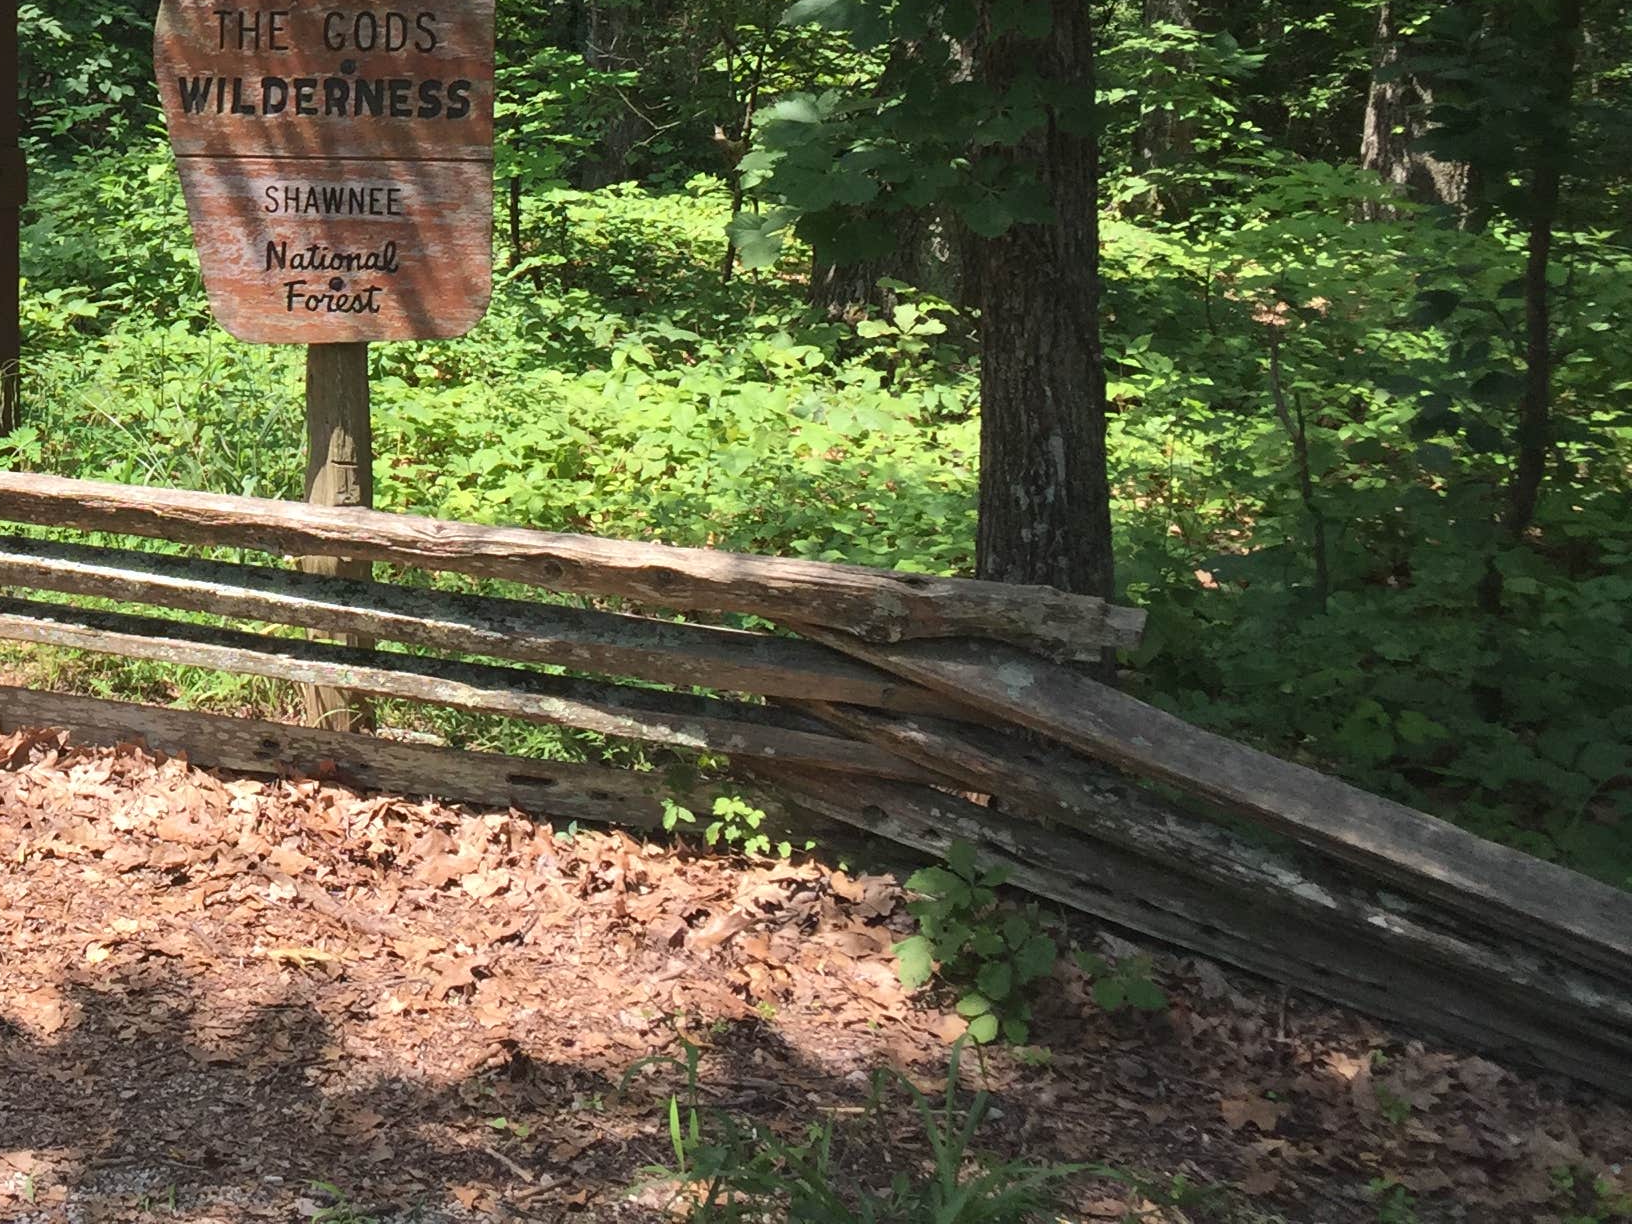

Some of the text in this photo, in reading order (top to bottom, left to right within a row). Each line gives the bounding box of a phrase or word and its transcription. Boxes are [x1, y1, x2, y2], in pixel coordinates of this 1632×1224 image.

[213, 10, 437, 53] THE GODS
[178, 76, 472, 120] WILDERNESS
[265, 185, 402, 216] SHAWNEE
[266, 241, 399, 274] National
[283, 279, 382, 314] Forest
